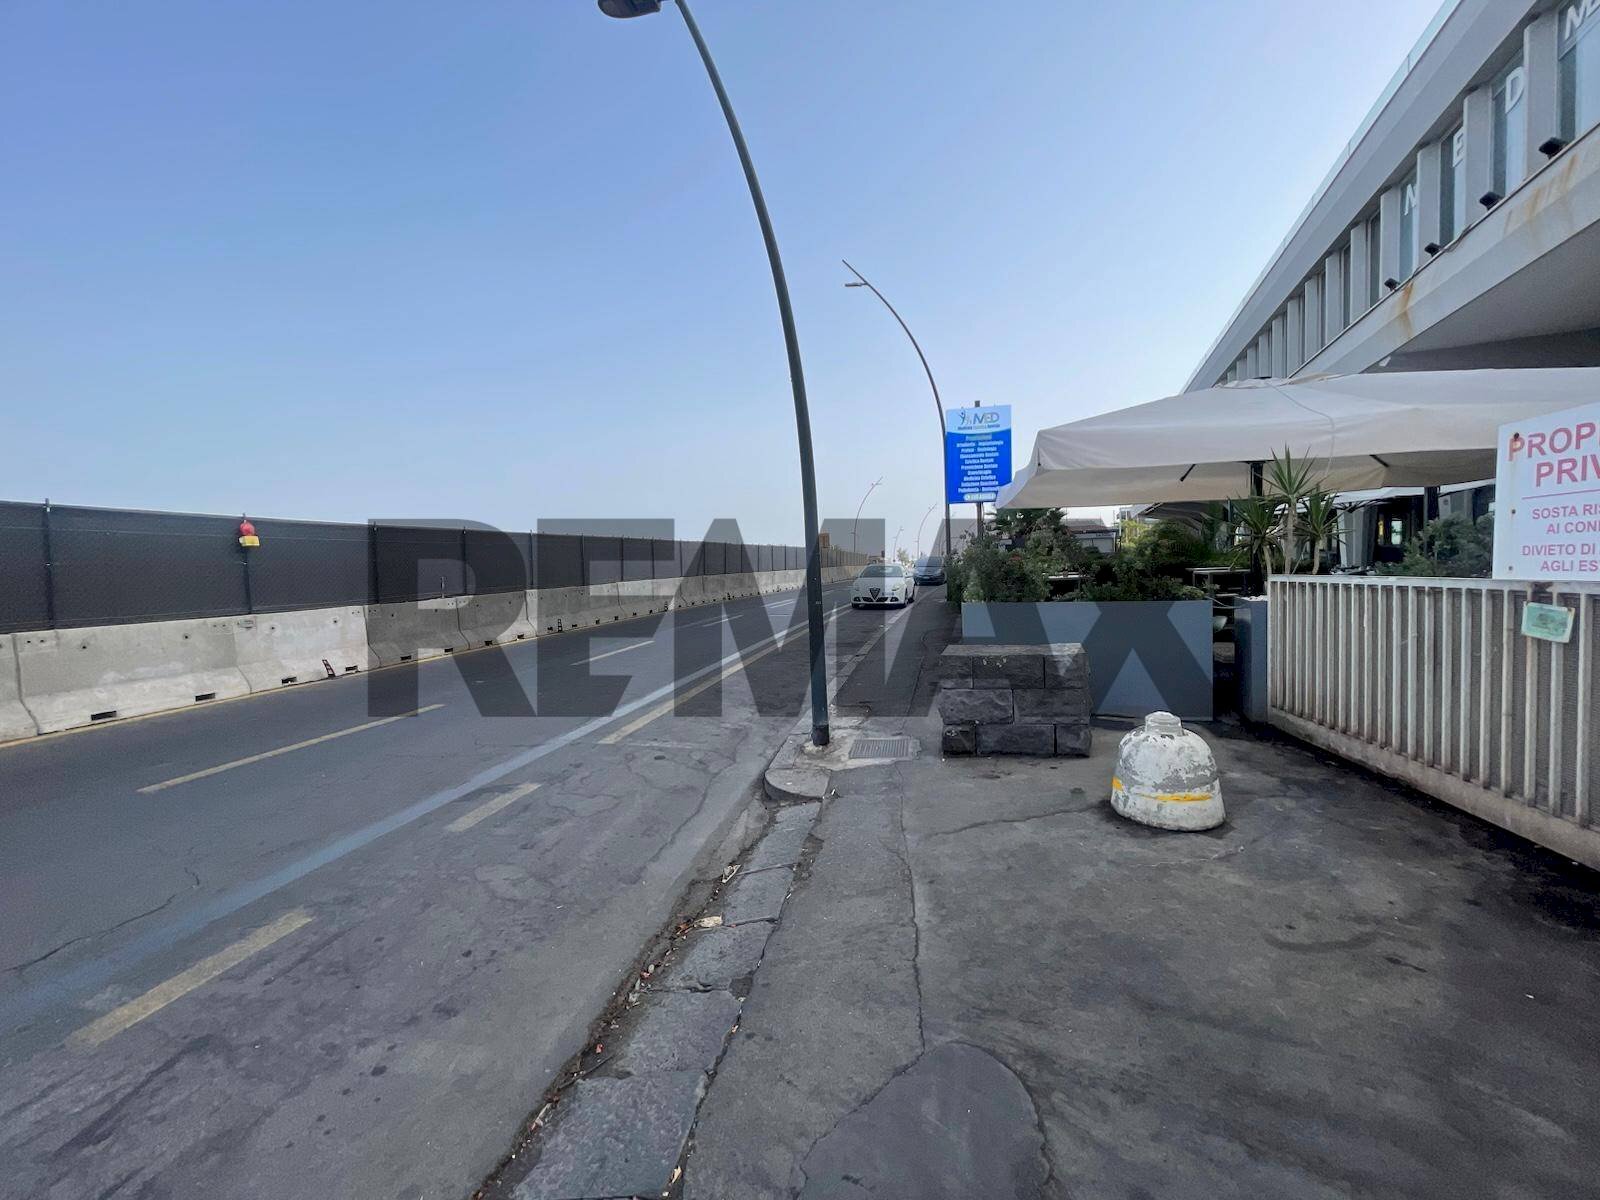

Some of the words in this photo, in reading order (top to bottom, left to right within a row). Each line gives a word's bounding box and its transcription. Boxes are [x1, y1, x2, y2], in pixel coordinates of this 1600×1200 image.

[1508, 422, 1600, 462] PROP
[1532, 505, 1578, 520] SOSTA
[1583, 503, 1600, 516] RI
[1546, 523, 1560, 535] AI
[1564, 520, 1600, 533] CON
[1521, 543, 1576, 556] DIVIETO
[1581, 543, 1596, 555] DI
[1540, 560, 1574, 572] AGLI
[1578, 560, 1599, 572] ES
